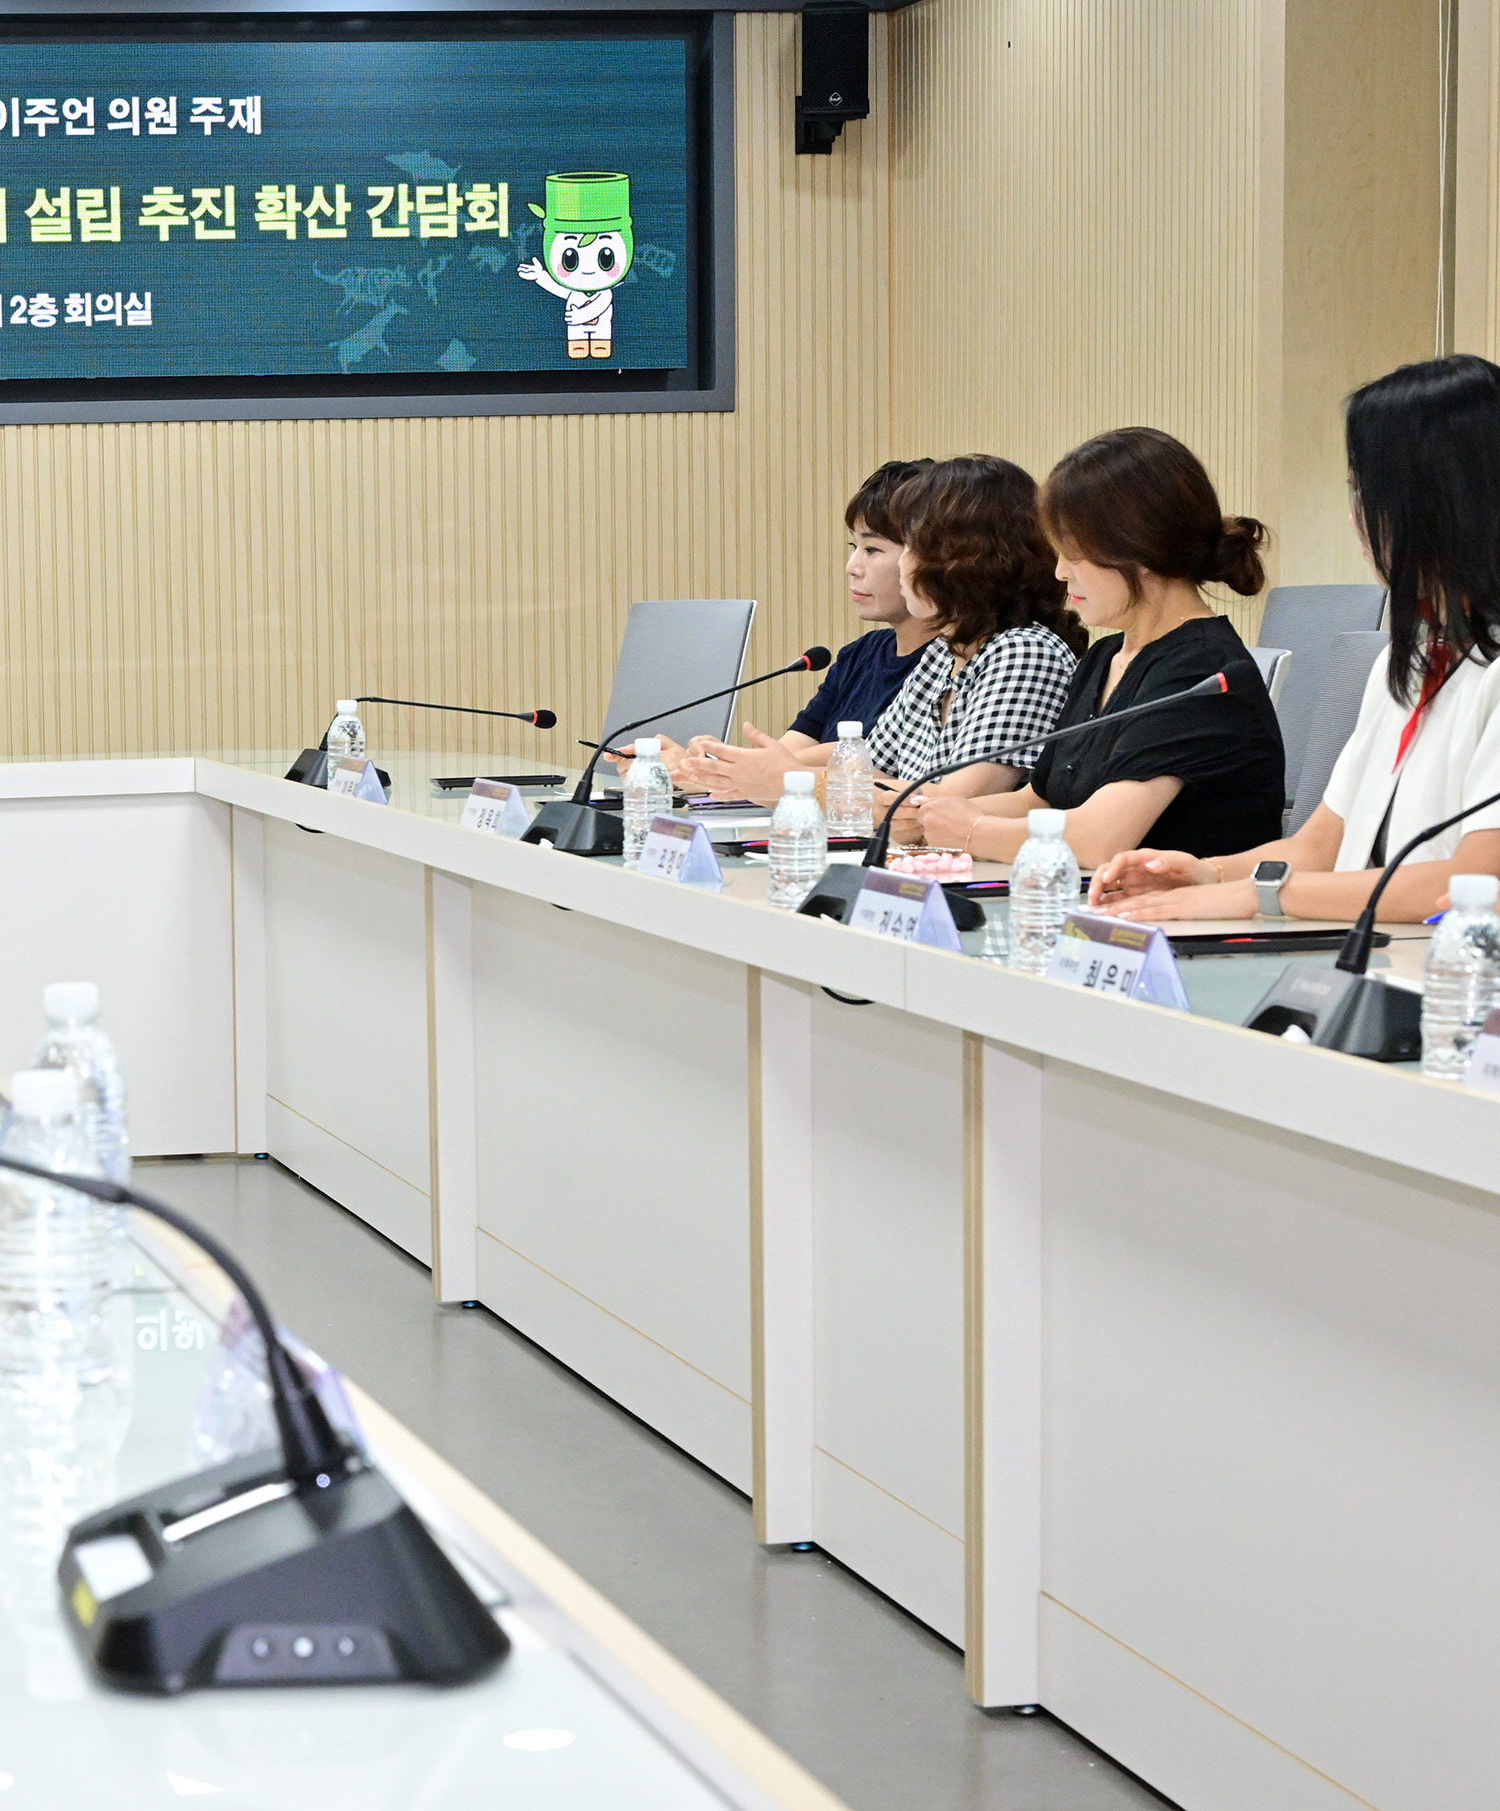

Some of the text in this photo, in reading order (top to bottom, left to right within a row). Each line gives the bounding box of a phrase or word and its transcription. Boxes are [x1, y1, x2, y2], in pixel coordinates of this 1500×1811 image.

[108, 97, 178, 137] 의원
[191, 96, 263, 137] 주재
[25, 187, 122, 244] 설립
[139, 186, 237, 243] 추진
[255, 185, 353, 241] 확산
[367, 183, 510, 240] 간담회
[10, 293, 58, 331] 2층
[64, 292, 154, 330] 회의실
